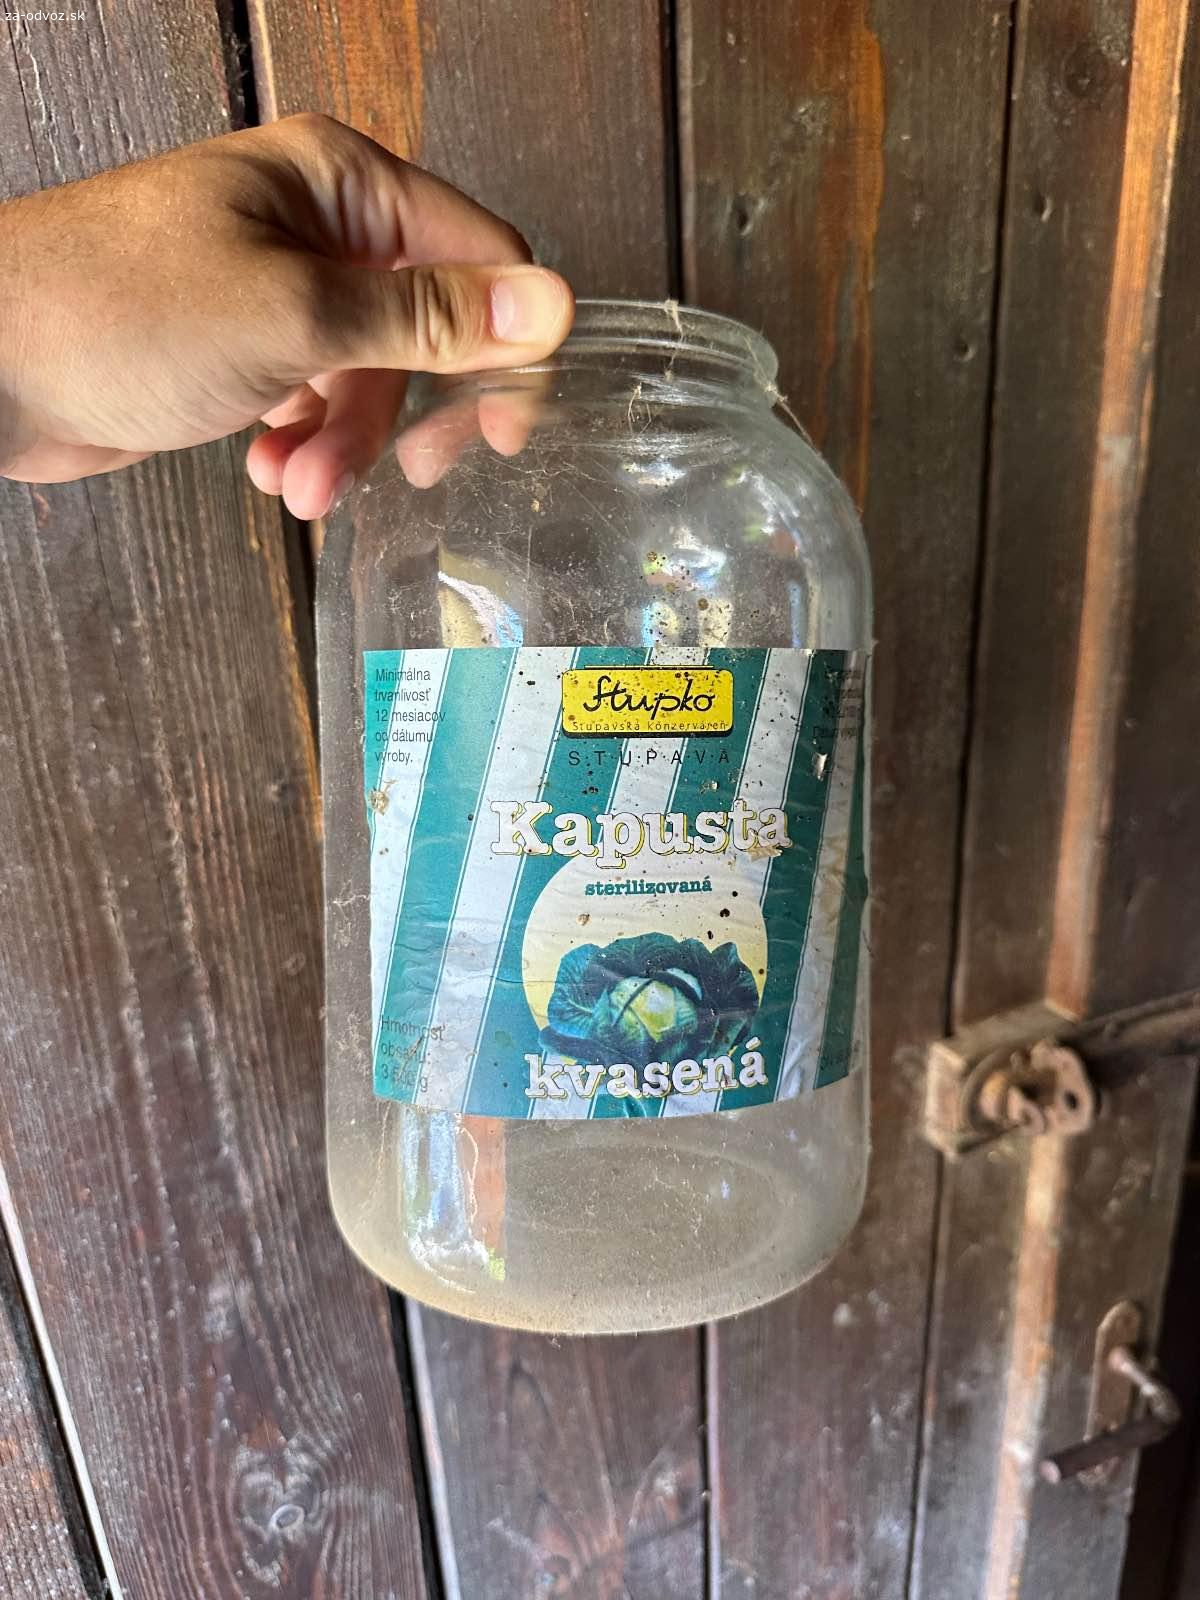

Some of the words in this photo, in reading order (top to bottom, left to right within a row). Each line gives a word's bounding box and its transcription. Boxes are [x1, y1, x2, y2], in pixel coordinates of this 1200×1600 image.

[376, 668, 431, 681] Minimálna
[375, 688, 431, 702] trvanlivosť
[376, 709, 389, 722] 12
[392, 708, 446, 722] mesiacov
[392, 729, 433, 742] dátumu
[490, 798, 791, 869] Kapusta
[585, 876, 712, 897] sterilizovaná
[524, 1037, 768, 1099] kvasená
